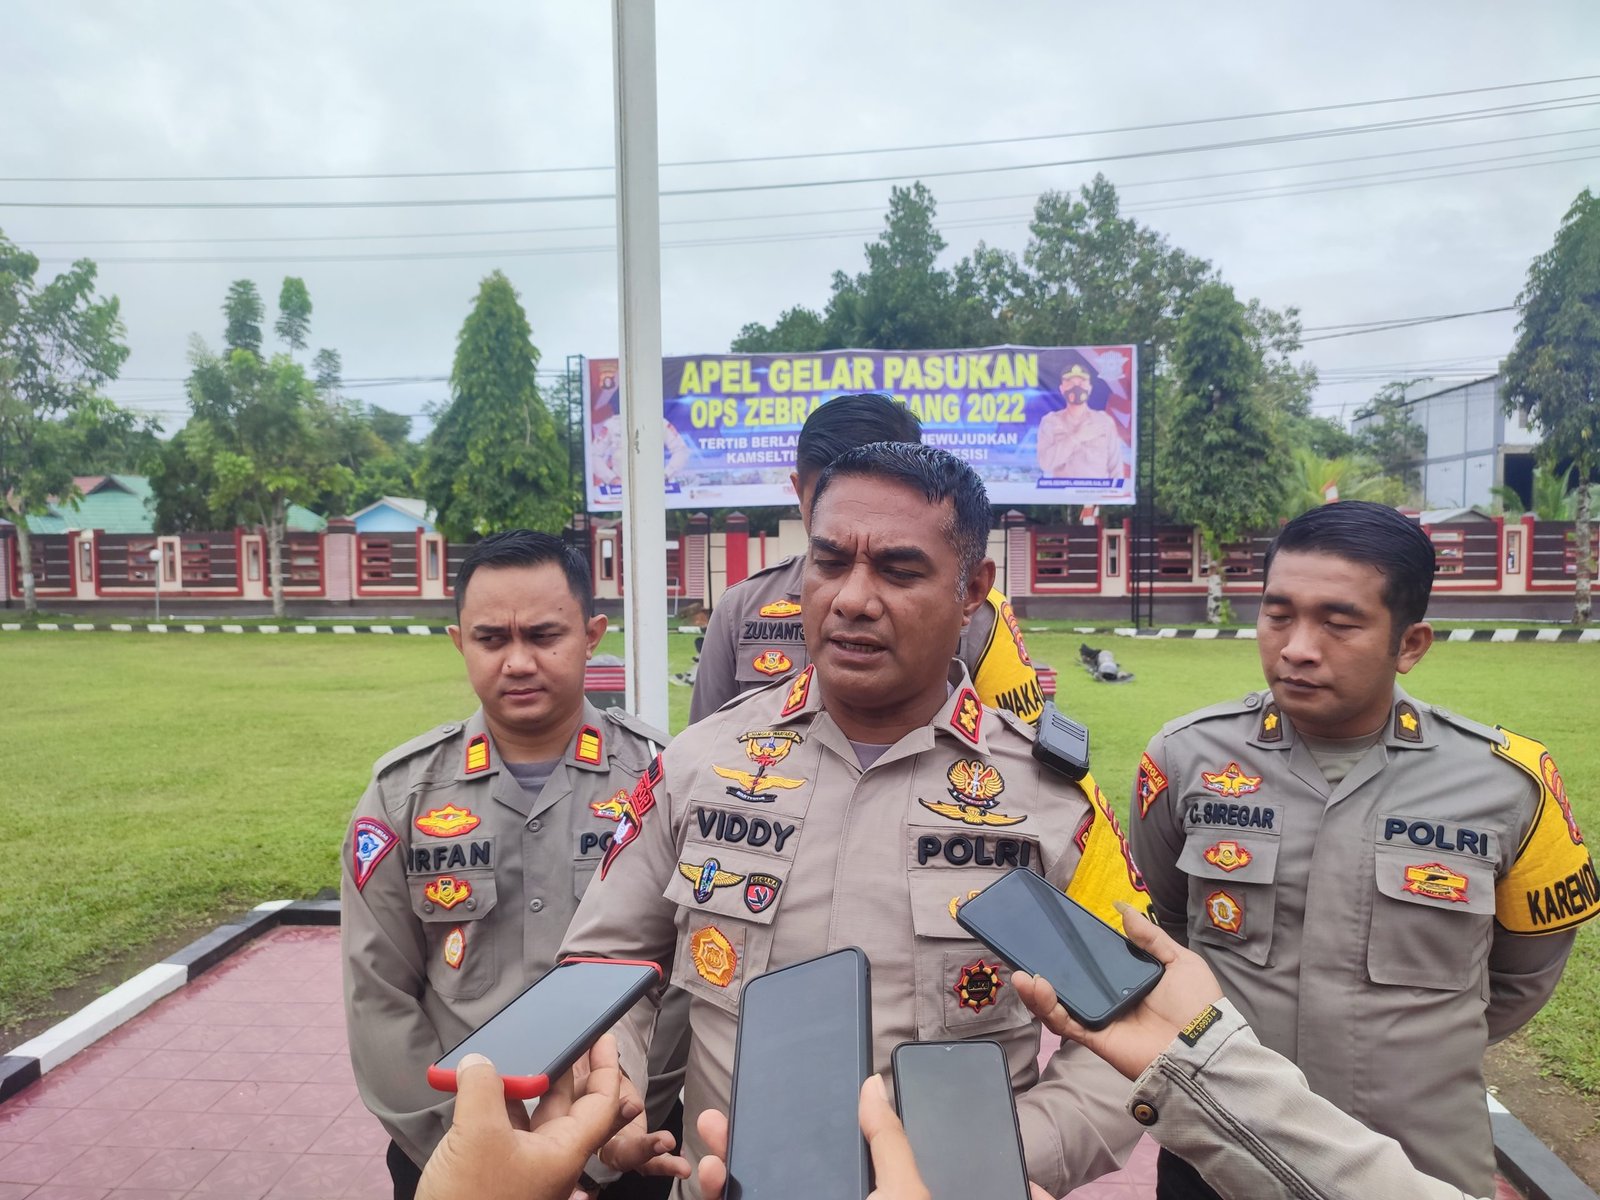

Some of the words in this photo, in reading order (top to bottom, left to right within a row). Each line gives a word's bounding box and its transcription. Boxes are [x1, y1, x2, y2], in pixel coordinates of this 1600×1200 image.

[680, 360, 760, 395] APEL
[768, 356, 876, 392] GELAR
[883, 353, 1039, 390] PASUKAN
[690, 399, 738, 429] OPS
[966, 393, 1026, 423] 2022
[699, 437, 747, 450] TERTIB
[726, 450, 798, 464] KAMSELTI
[995, 675, 1046, 718] WAKA
[697, 807, 795, 853] VIDDY
[1203, 803, 1275, 829] SIREGAR
[917, 835, 1031, 867] POLRI
[1384, 817, 1488, 856] POLRI
[408, 840, 491, 872] IRFAN
